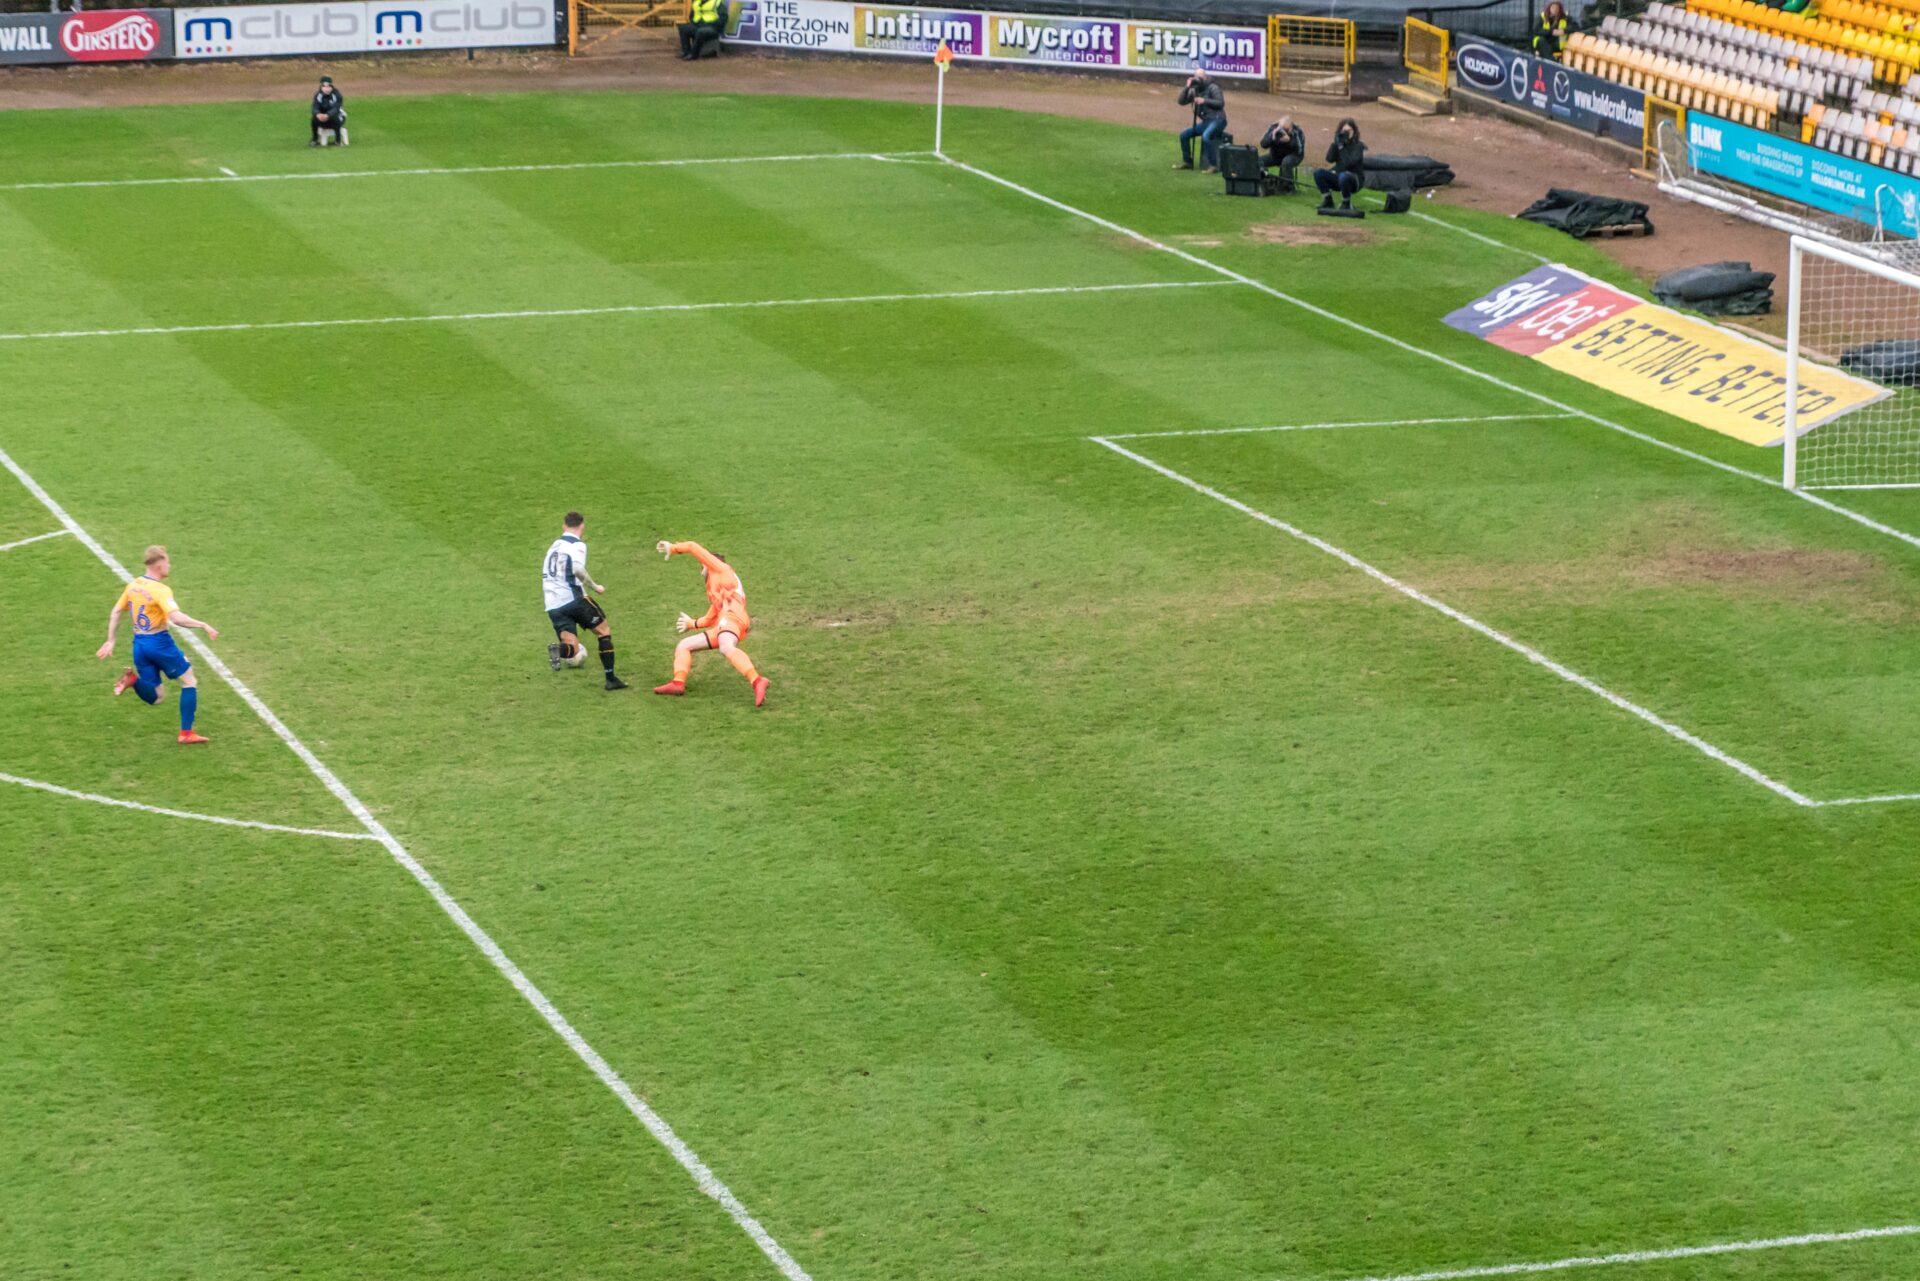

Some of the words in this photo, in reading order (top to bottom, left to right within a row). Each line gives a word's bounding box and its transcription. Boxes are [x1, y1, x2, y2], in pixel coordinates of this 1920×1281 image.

[764, 1, 798, 15] THE
[62, 15, 155, 52] GINSTERS
[765, 16, 849, 34] FITZJOHN
[865, 10, 973, 41] Intium
[998, 19, 1114, 52] Mycroft
[764, 30, 828, 46] GROUP
[865, 36, 942, 51] Constructio
[952, 41, 972, 54] Ltd
[1135, 27, 1255, 59] Fitzjohn
[1040, 49, 1113, 64] Interiors
[1137, 56, 1186, 69] Painting
[1205, 60, 1255, 73] Flooring
[1464, 55, 1500, 78] HOLDCROFT
[1690, 122, 1722, 152] BLINK
[1472, 276, 1561, 328] sky
[1518, 291, 1617, 340] bet
